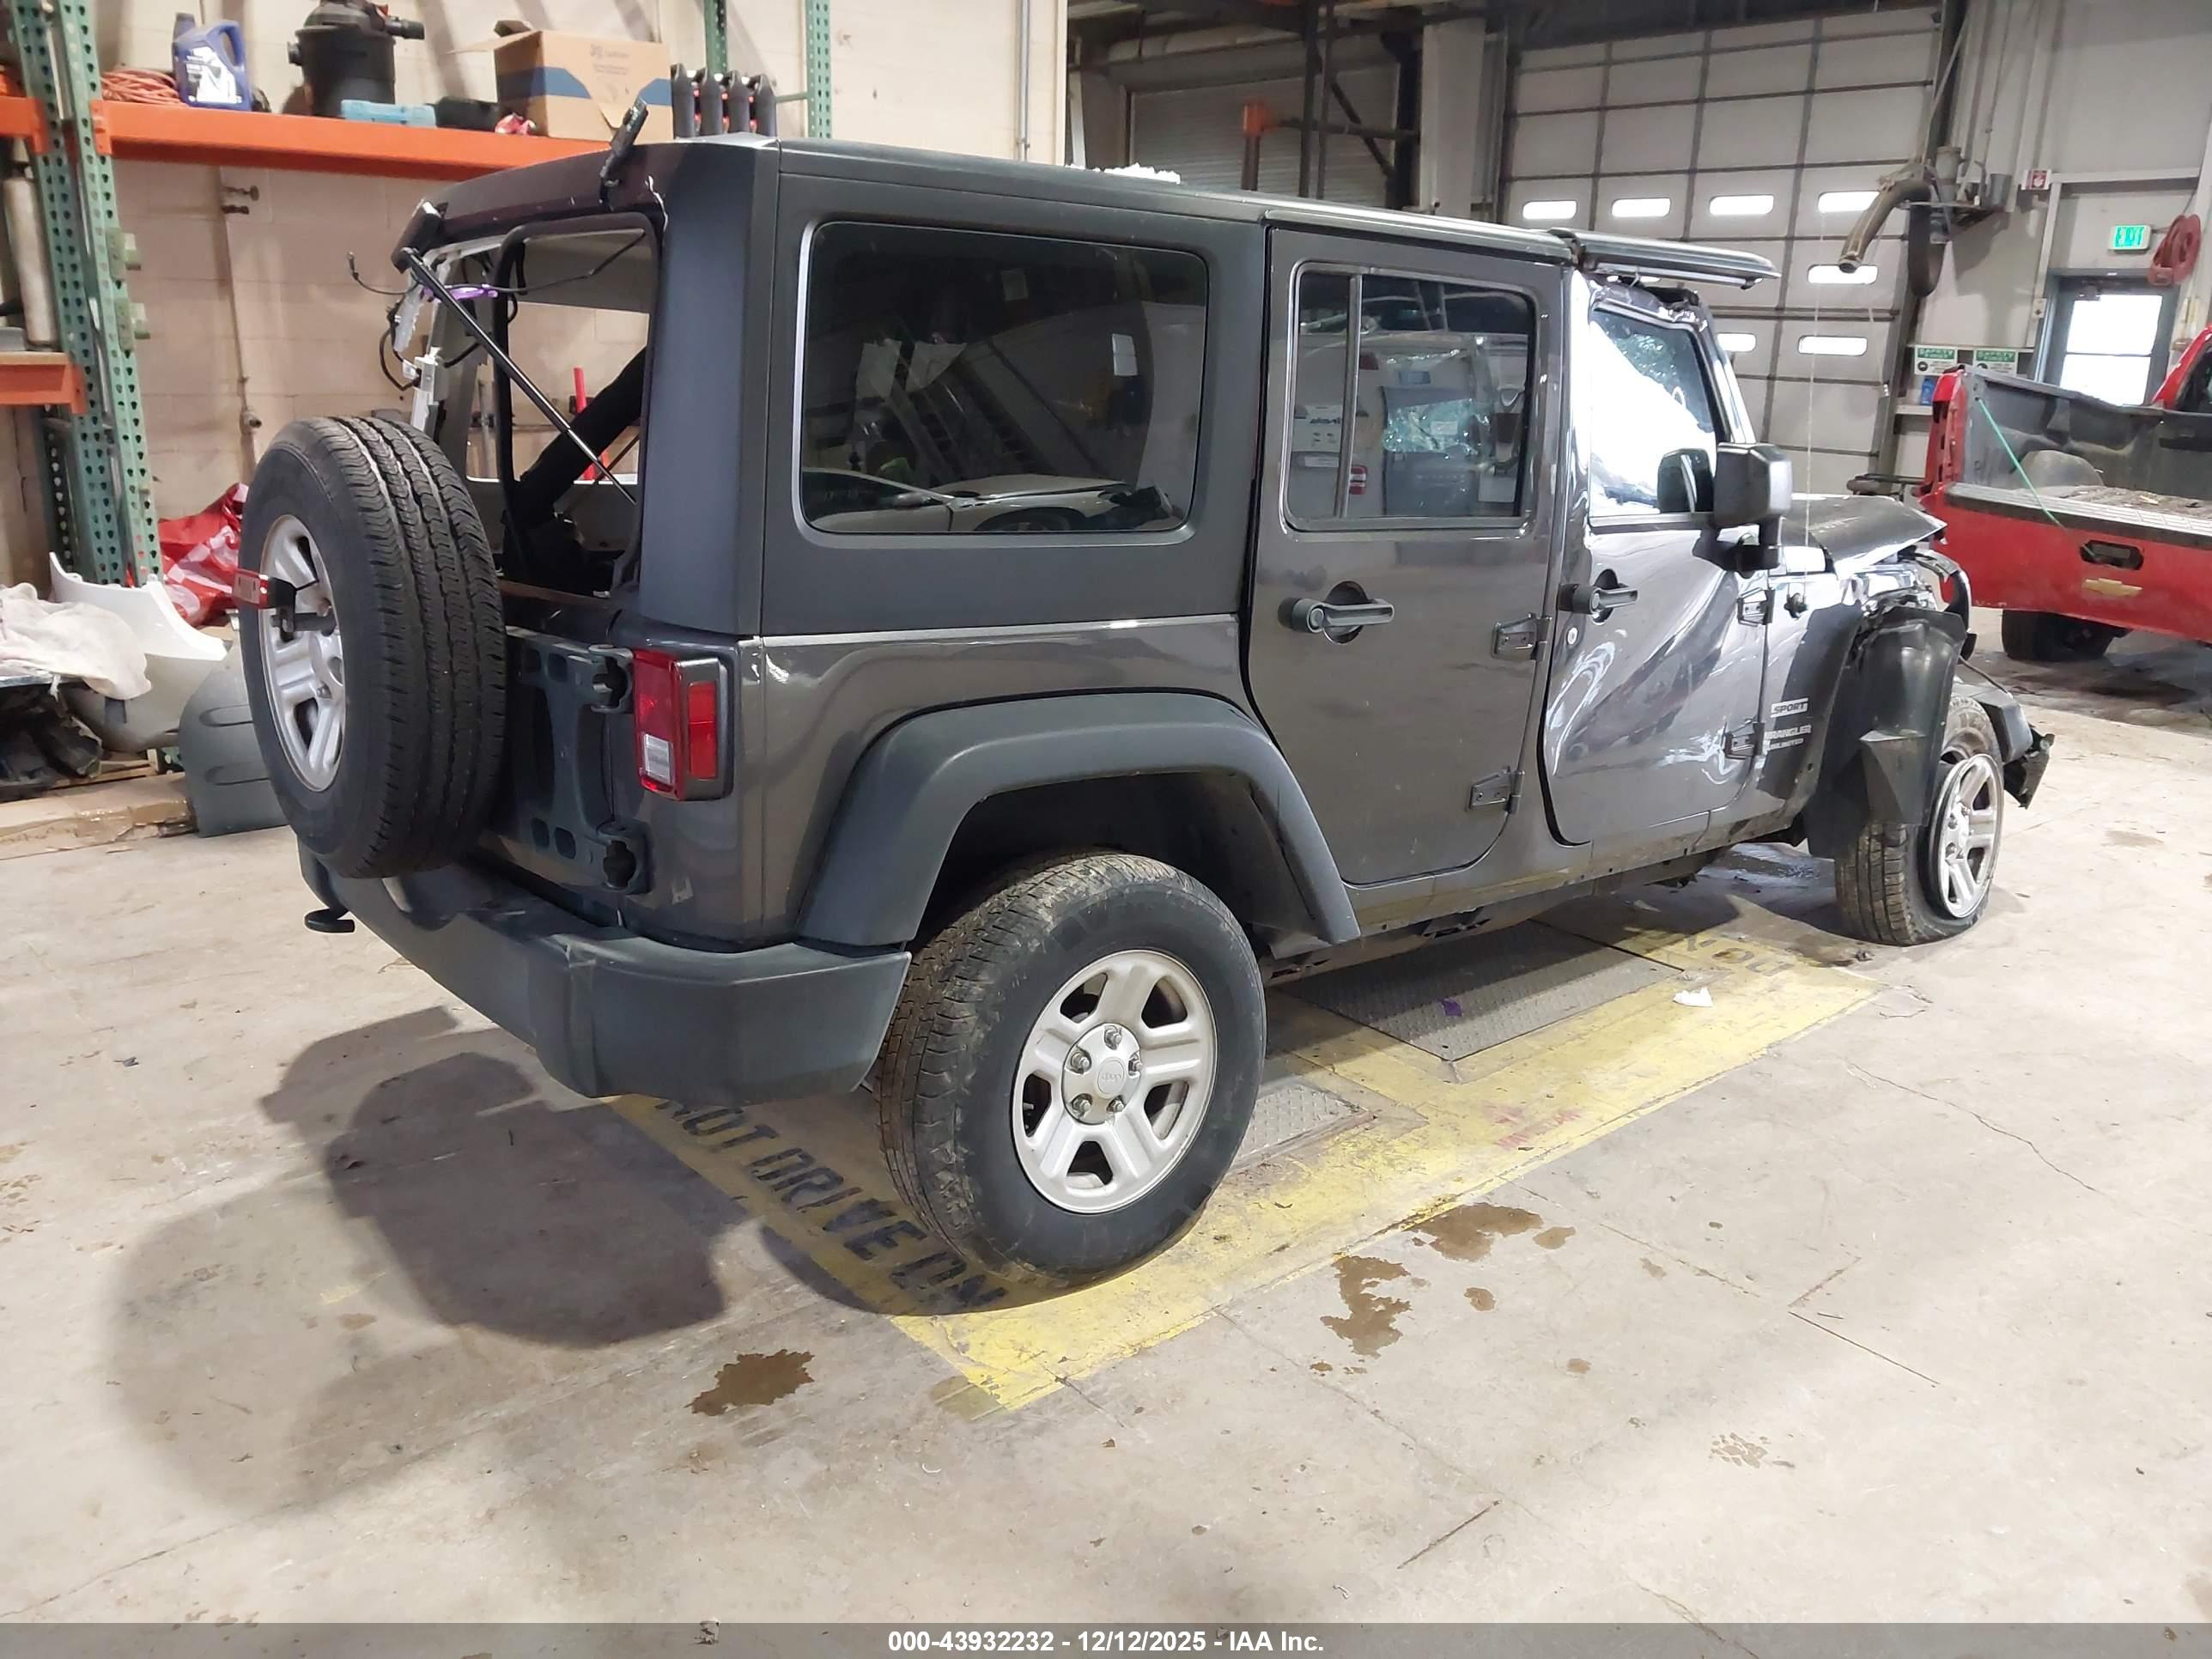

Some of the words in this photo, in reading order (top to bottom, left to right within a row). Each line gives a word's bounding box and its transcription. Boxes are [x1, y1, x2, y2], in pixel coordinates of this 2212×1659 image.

[2115, 226, 2144, 247] EXIT
[1773, 703, 1805, 714] SPORT
[745, 1147, 929, 1261] DRIVE
[888, 1251, 1011, 1308] ON
